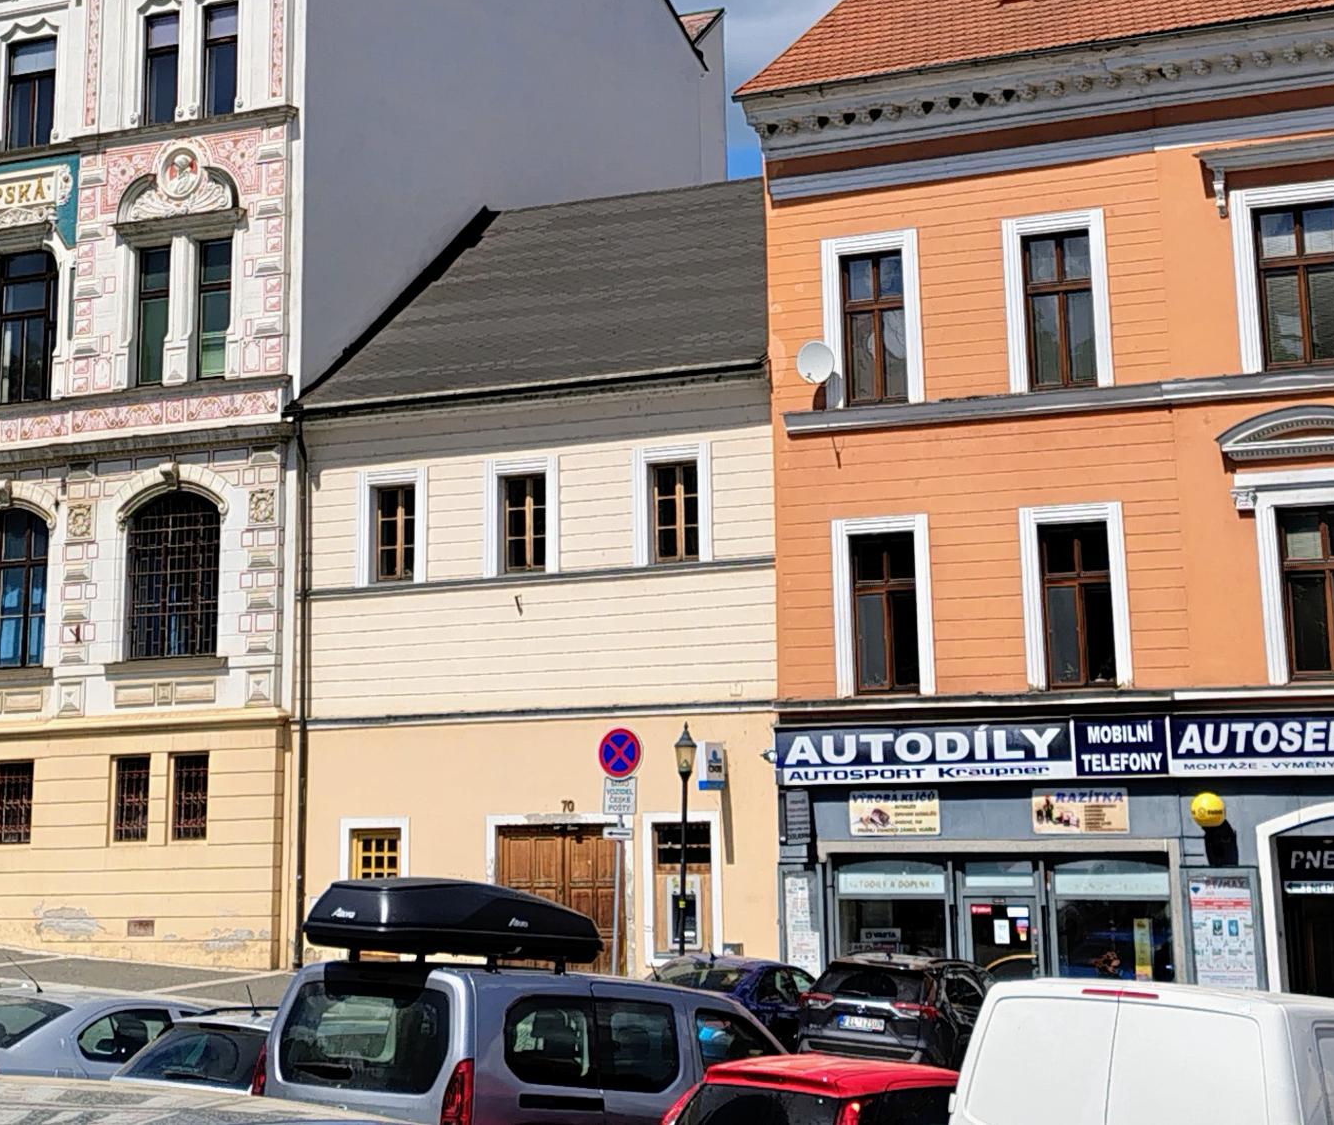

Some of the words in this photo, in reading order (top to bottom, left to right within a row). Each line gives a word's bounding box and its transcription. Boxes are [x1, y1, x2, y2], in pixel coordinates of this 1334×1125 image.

[1087, 720, 1153, 744] MOBILNÍ
[784, 725, 1060, 765] AUTODÍLY
[1081, 752, 1163, 772] TELEFONY
[1183, 759, 1258, 771] MONTÁŽE
[789, 768, 926, 782] AUTOSPORT
[938, 767, 1050, 779] Kraupner
[852, 792, 898, 803] VÝROBA
[901, 790, 935, 802] KLÍČŮ
[1056, 790, 1123, 802] RAZÍTKA
[561, 800, 574, 812] 70
